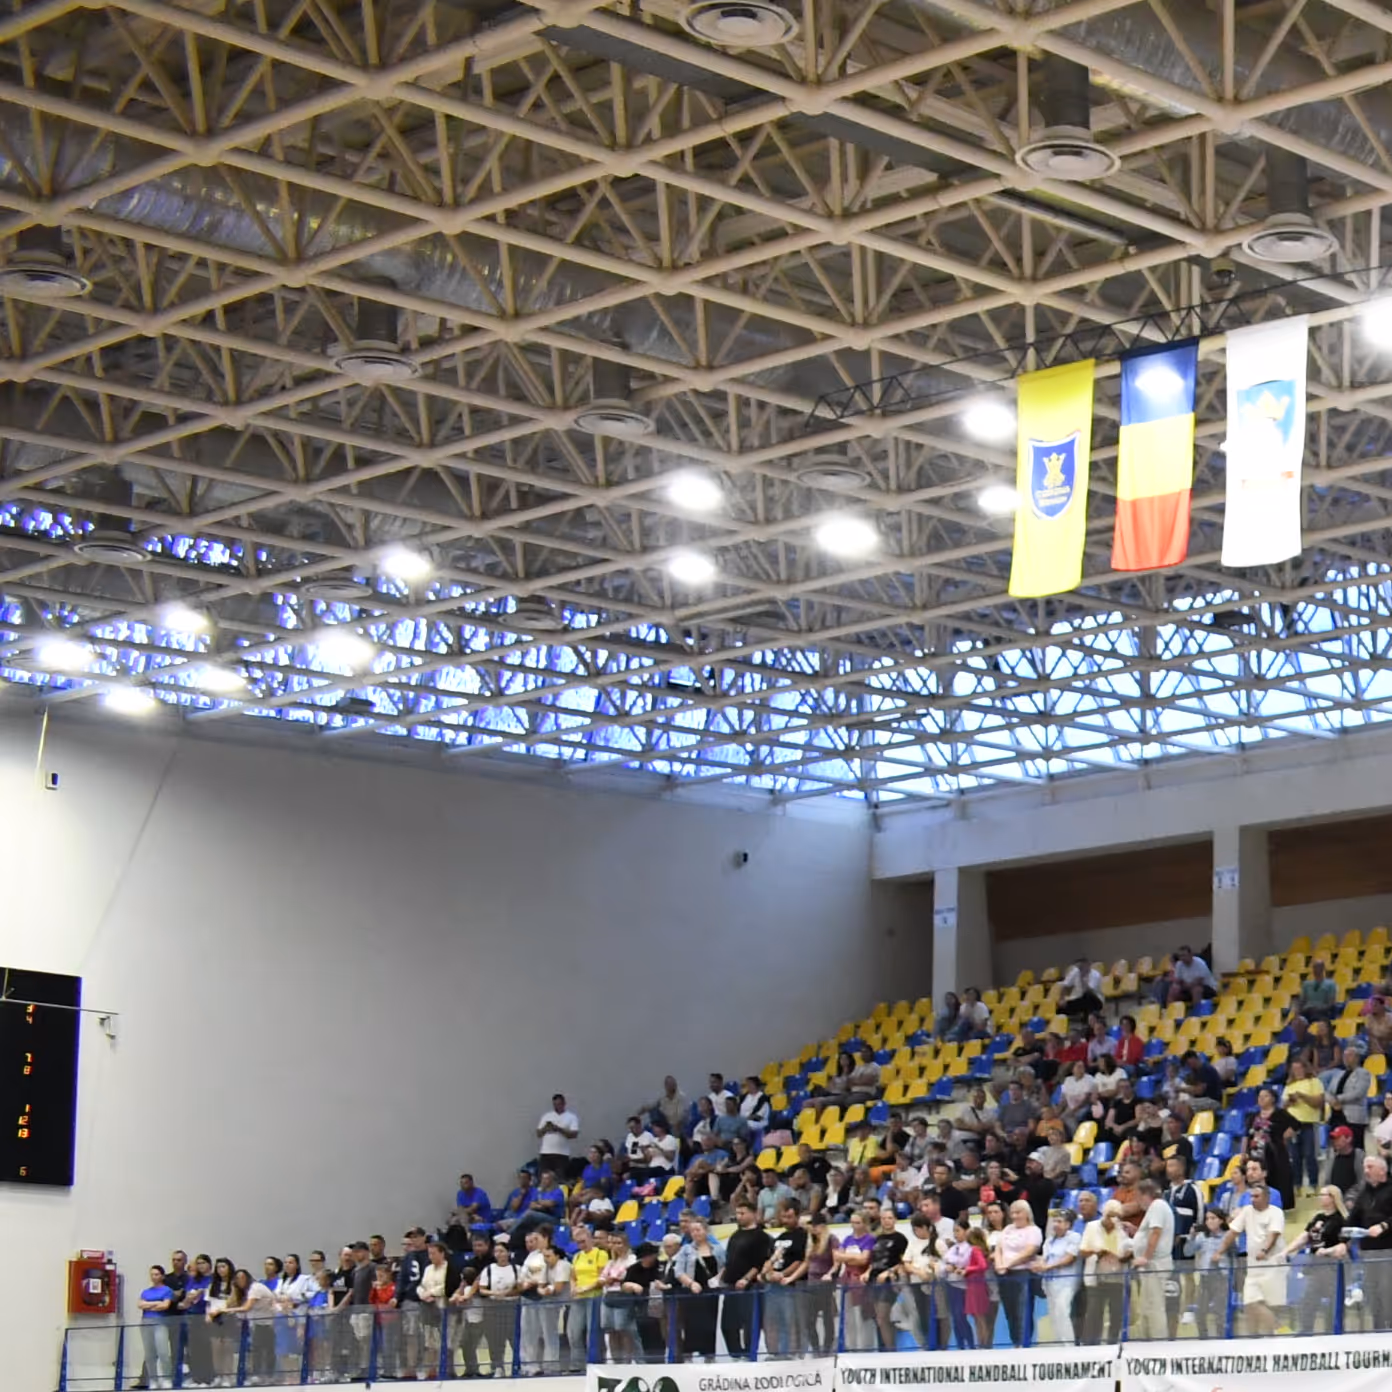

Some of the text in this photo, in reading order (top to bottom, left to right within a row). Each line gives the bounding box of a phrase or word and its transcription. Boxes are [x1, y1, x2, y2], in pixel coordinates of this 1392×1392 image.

[841, 1360, 1113, 1385] YOUTH INTERNATIONAL HANDBALL TOURNAMENT
[1126, 1358, 1166, 1376] YOUTH
[1171, 1355, 1268, 1375] INTERNATIONAL
[1272, 1351, 1340, 1373] HANDBALL
